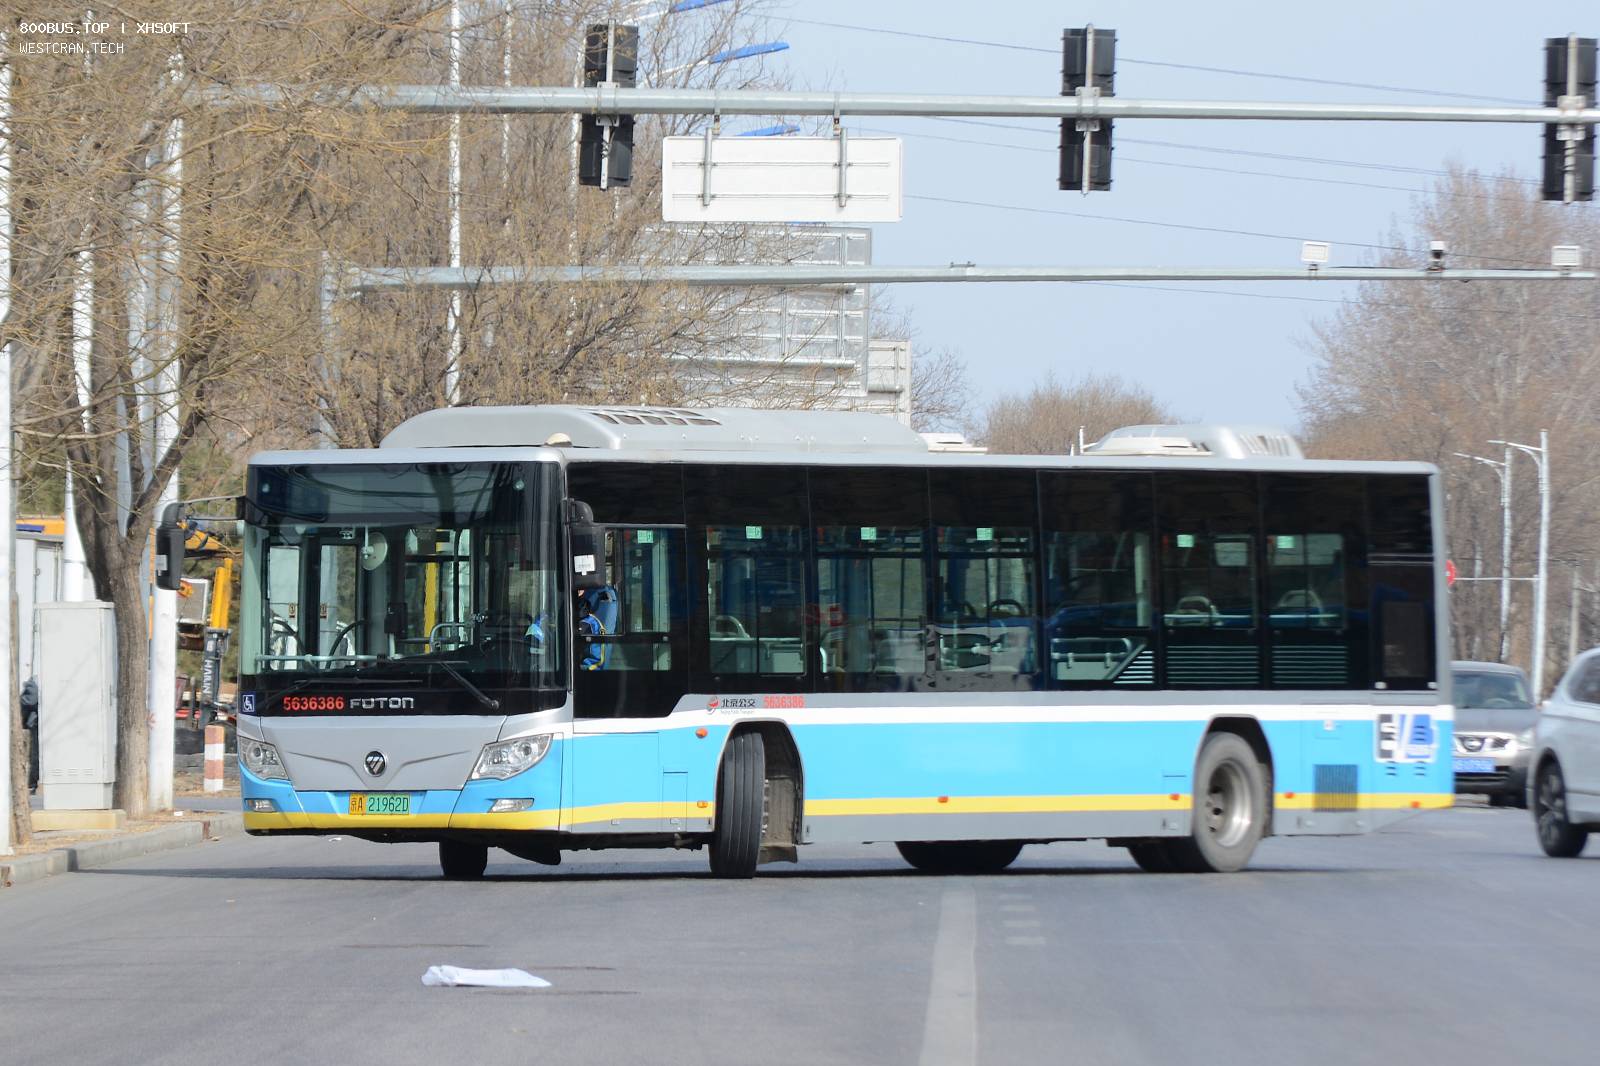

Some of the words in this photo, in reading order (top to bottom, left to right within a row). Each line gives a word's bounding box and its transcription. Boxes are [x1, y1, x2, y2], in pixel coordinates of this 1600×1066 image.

[282, 696, 345, 711] 5636386
[350, 697, 414, 709] FOTON
[721, 698, 756, 708] 北京公交
